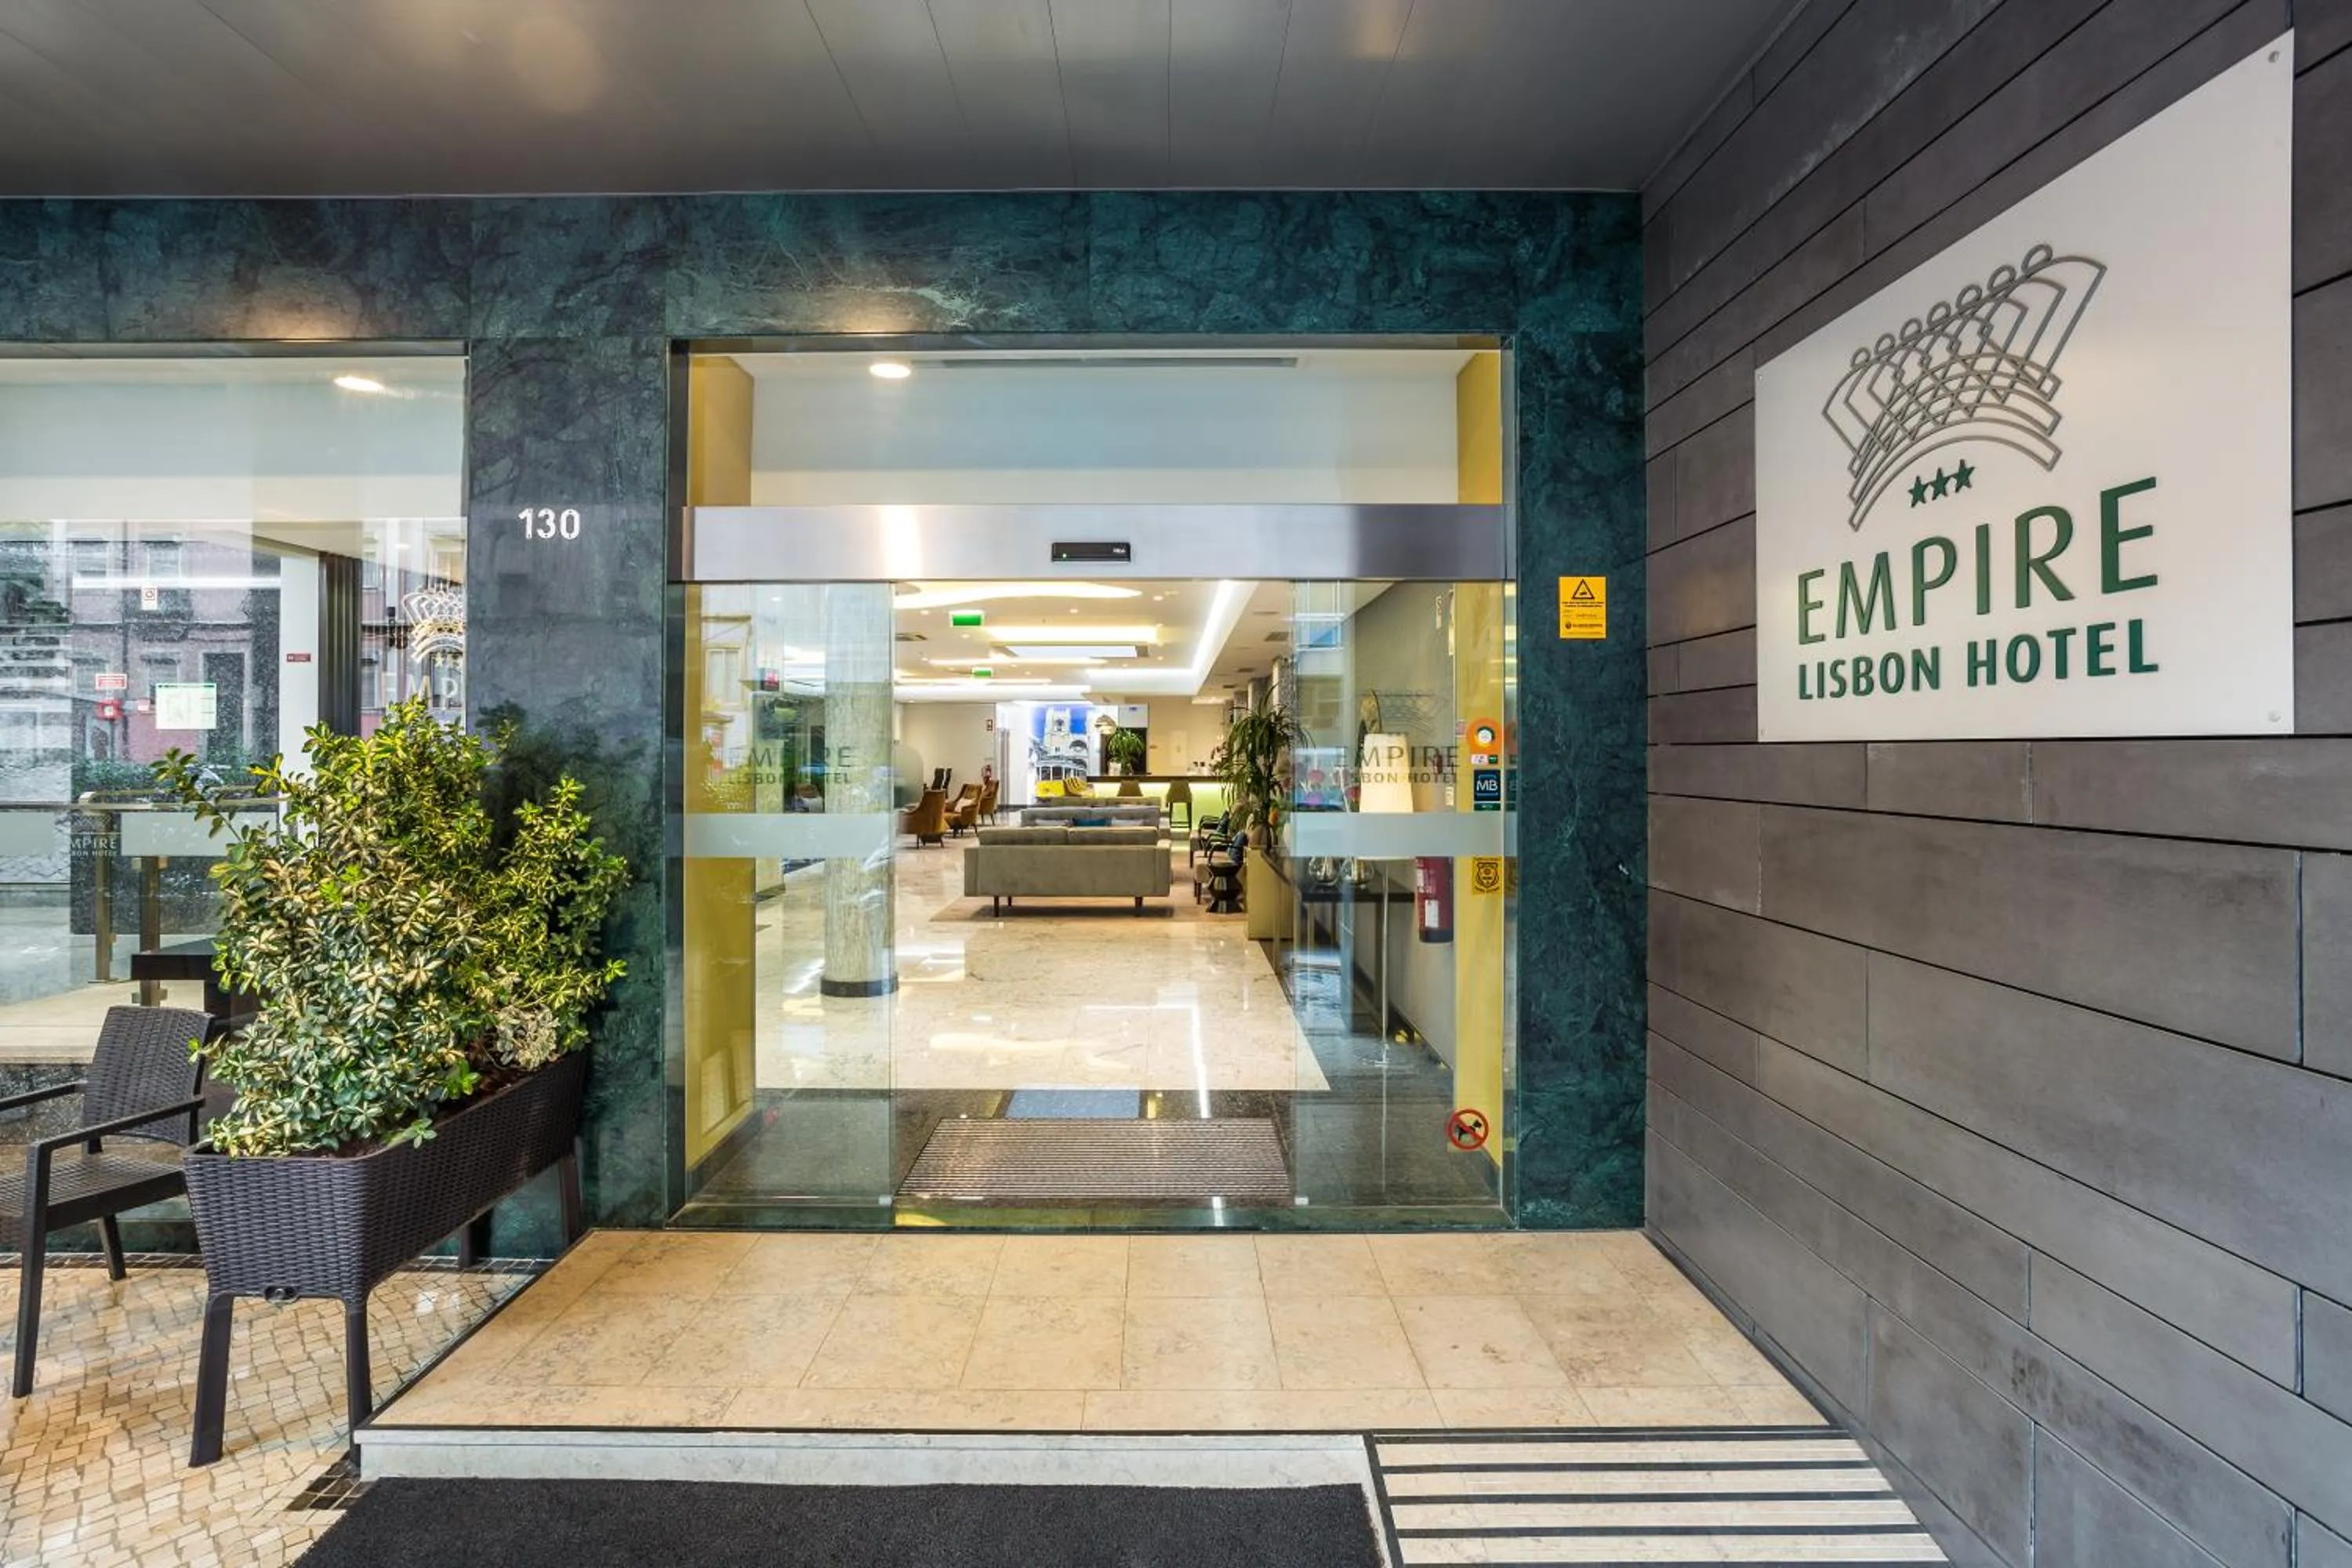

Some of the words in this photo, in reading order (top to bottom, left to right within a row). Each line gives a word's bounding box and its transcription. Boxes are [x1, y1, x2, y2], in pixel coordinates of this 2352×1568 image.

[518, 508, 579, 539] 130
[1798, 476, 2158, 644] EMPIRE
[1798, 647, 1940, 700] LISBON
[1967, 619, 2158, 687] HOTEL
[728, 747, 851, 768] EMIRE
[1334, 746, 1460, 767] EMPIRE
[799, 773, 851, 784] HTEL
[1333, 773, 1398, 783] SBON
[1476, 780, 1498, 791] MB
[70, 837, 117, 849] MPIRE
